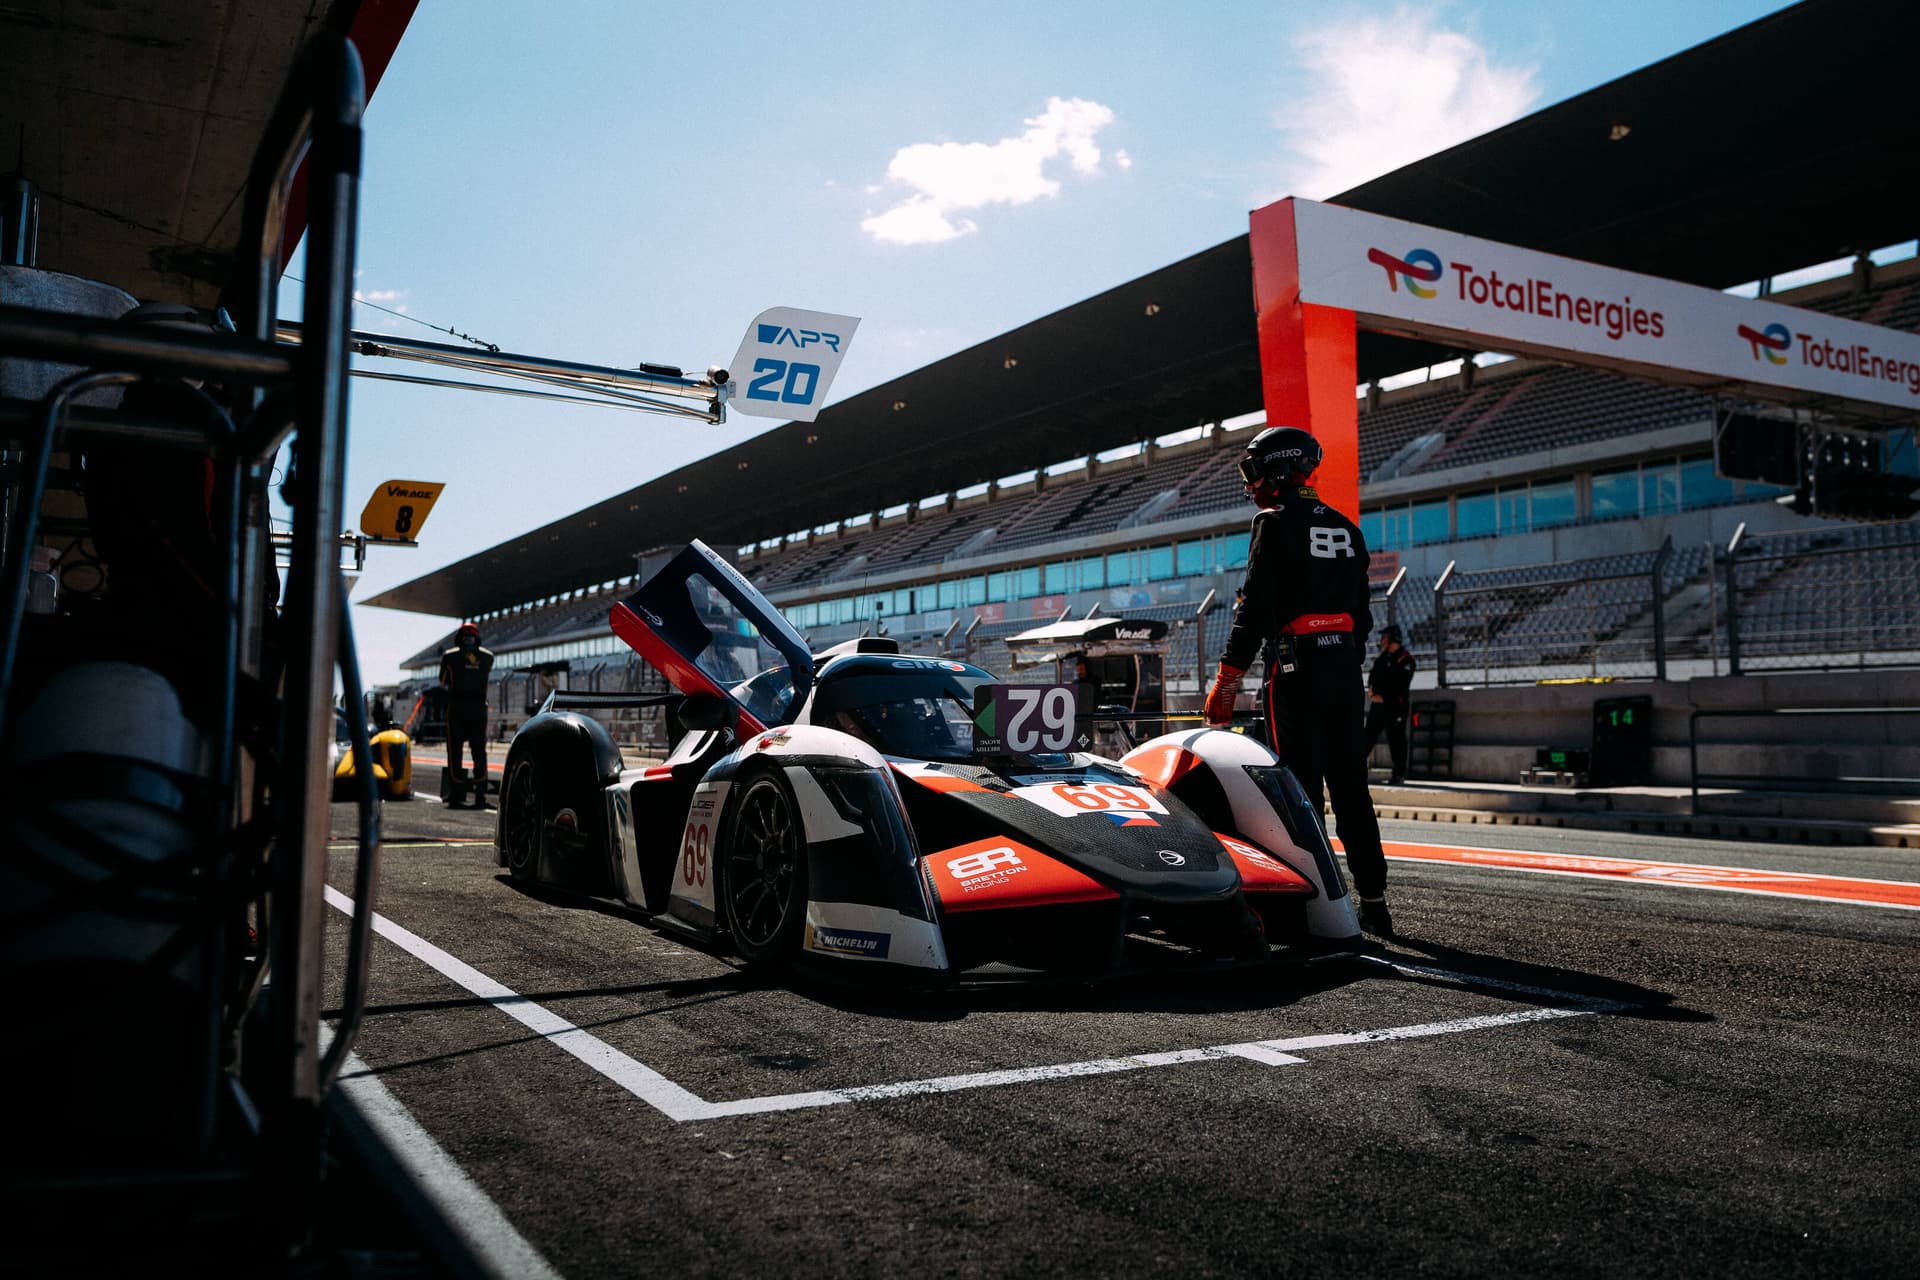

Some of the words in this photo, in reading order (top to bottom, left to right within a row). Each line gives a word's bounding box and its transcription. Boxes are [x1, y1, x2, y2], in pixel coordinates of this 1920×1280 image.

[1450, 262, 1665, 340] TotalEnergies
[777, 327, 840, 352] APR
[746, 358, 820, 405] 20
[395, 505, 413, 533] 8
[1052, 785, 1151, 810] 69
[683, 822, 709, 888] 69
[960, 865, 1028, 887] BRETTON
[964, 876, 1010, 893] RACING
[824, 935, 878, 950] MICHELIN
